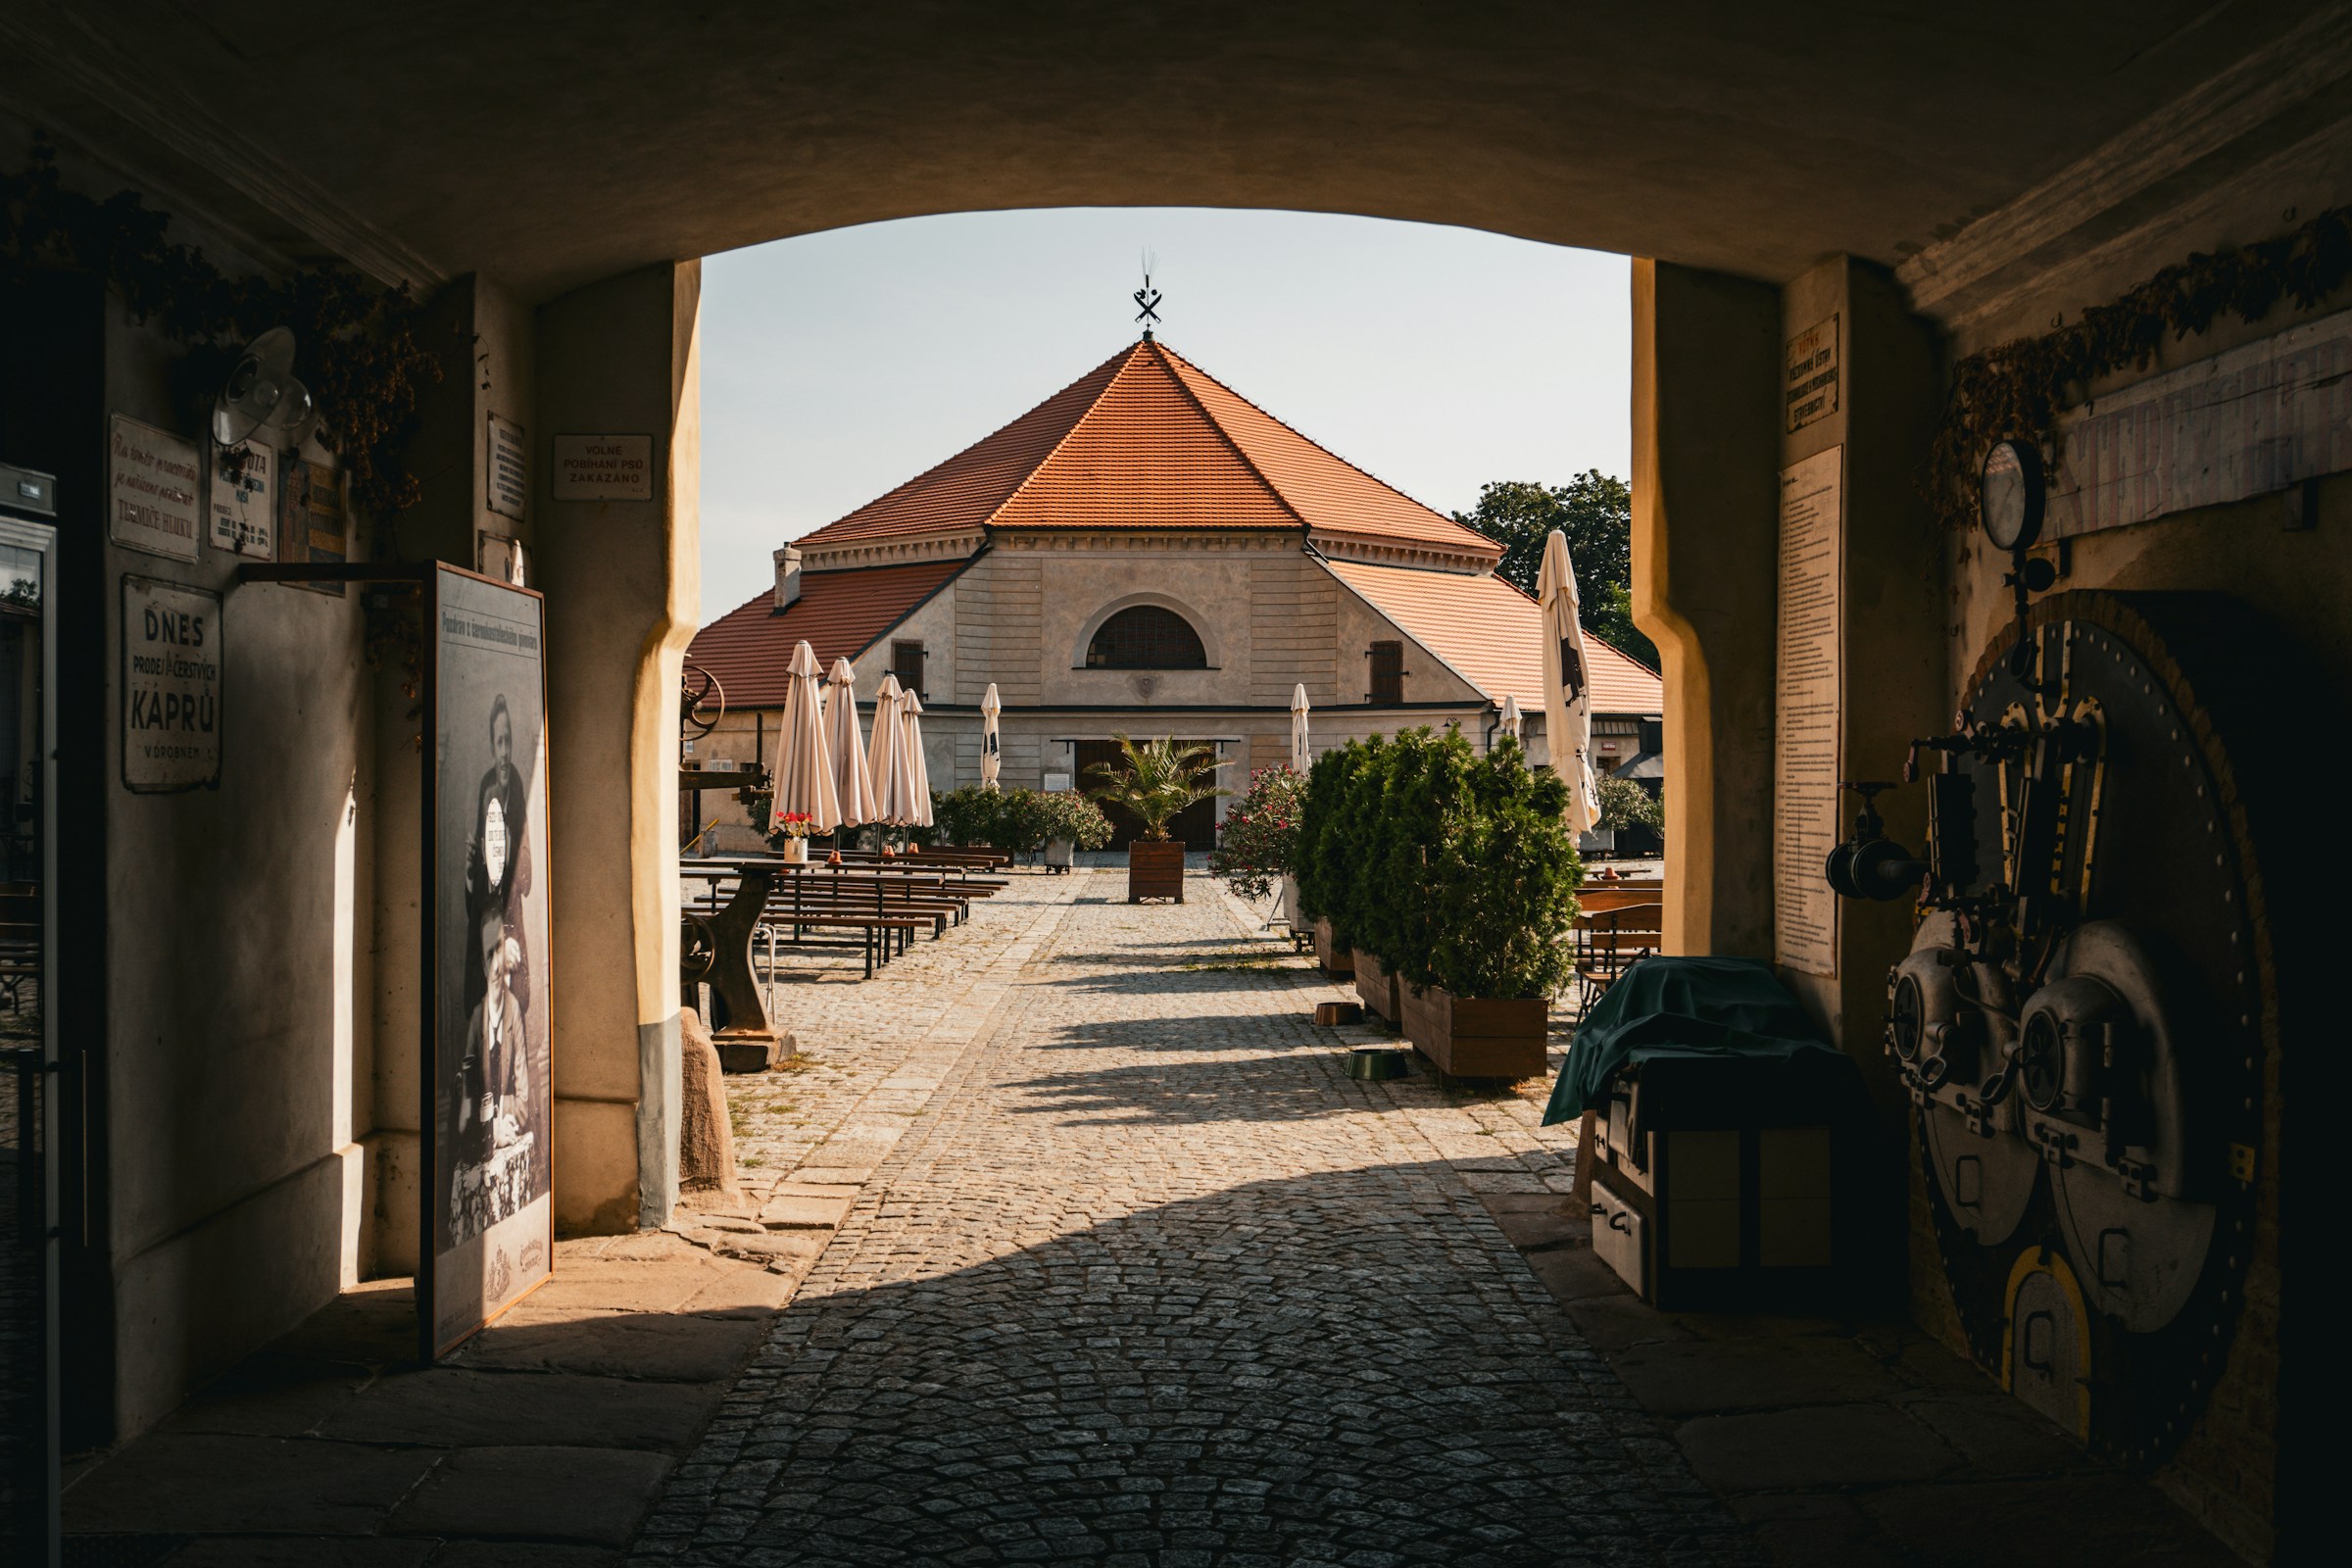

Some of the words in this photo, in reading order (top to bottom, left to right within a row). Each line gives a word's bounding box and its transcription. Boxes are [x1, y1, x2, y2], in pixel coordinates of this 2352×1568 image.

[585, 445, 622, 456] VOLNÉ
[621, 458, 643, 469] PSŮ
[162, 513, 194, 539] HLUKU
[144, 608, 204, 647] DNES
[442, 612, 466, 635] Pozdrav
[133, 655, 165, 675] PRODEJ
[173, 654, 216, 680] ČERSTVÝCH
[131, 687, 214, 732] KAPRŮ
